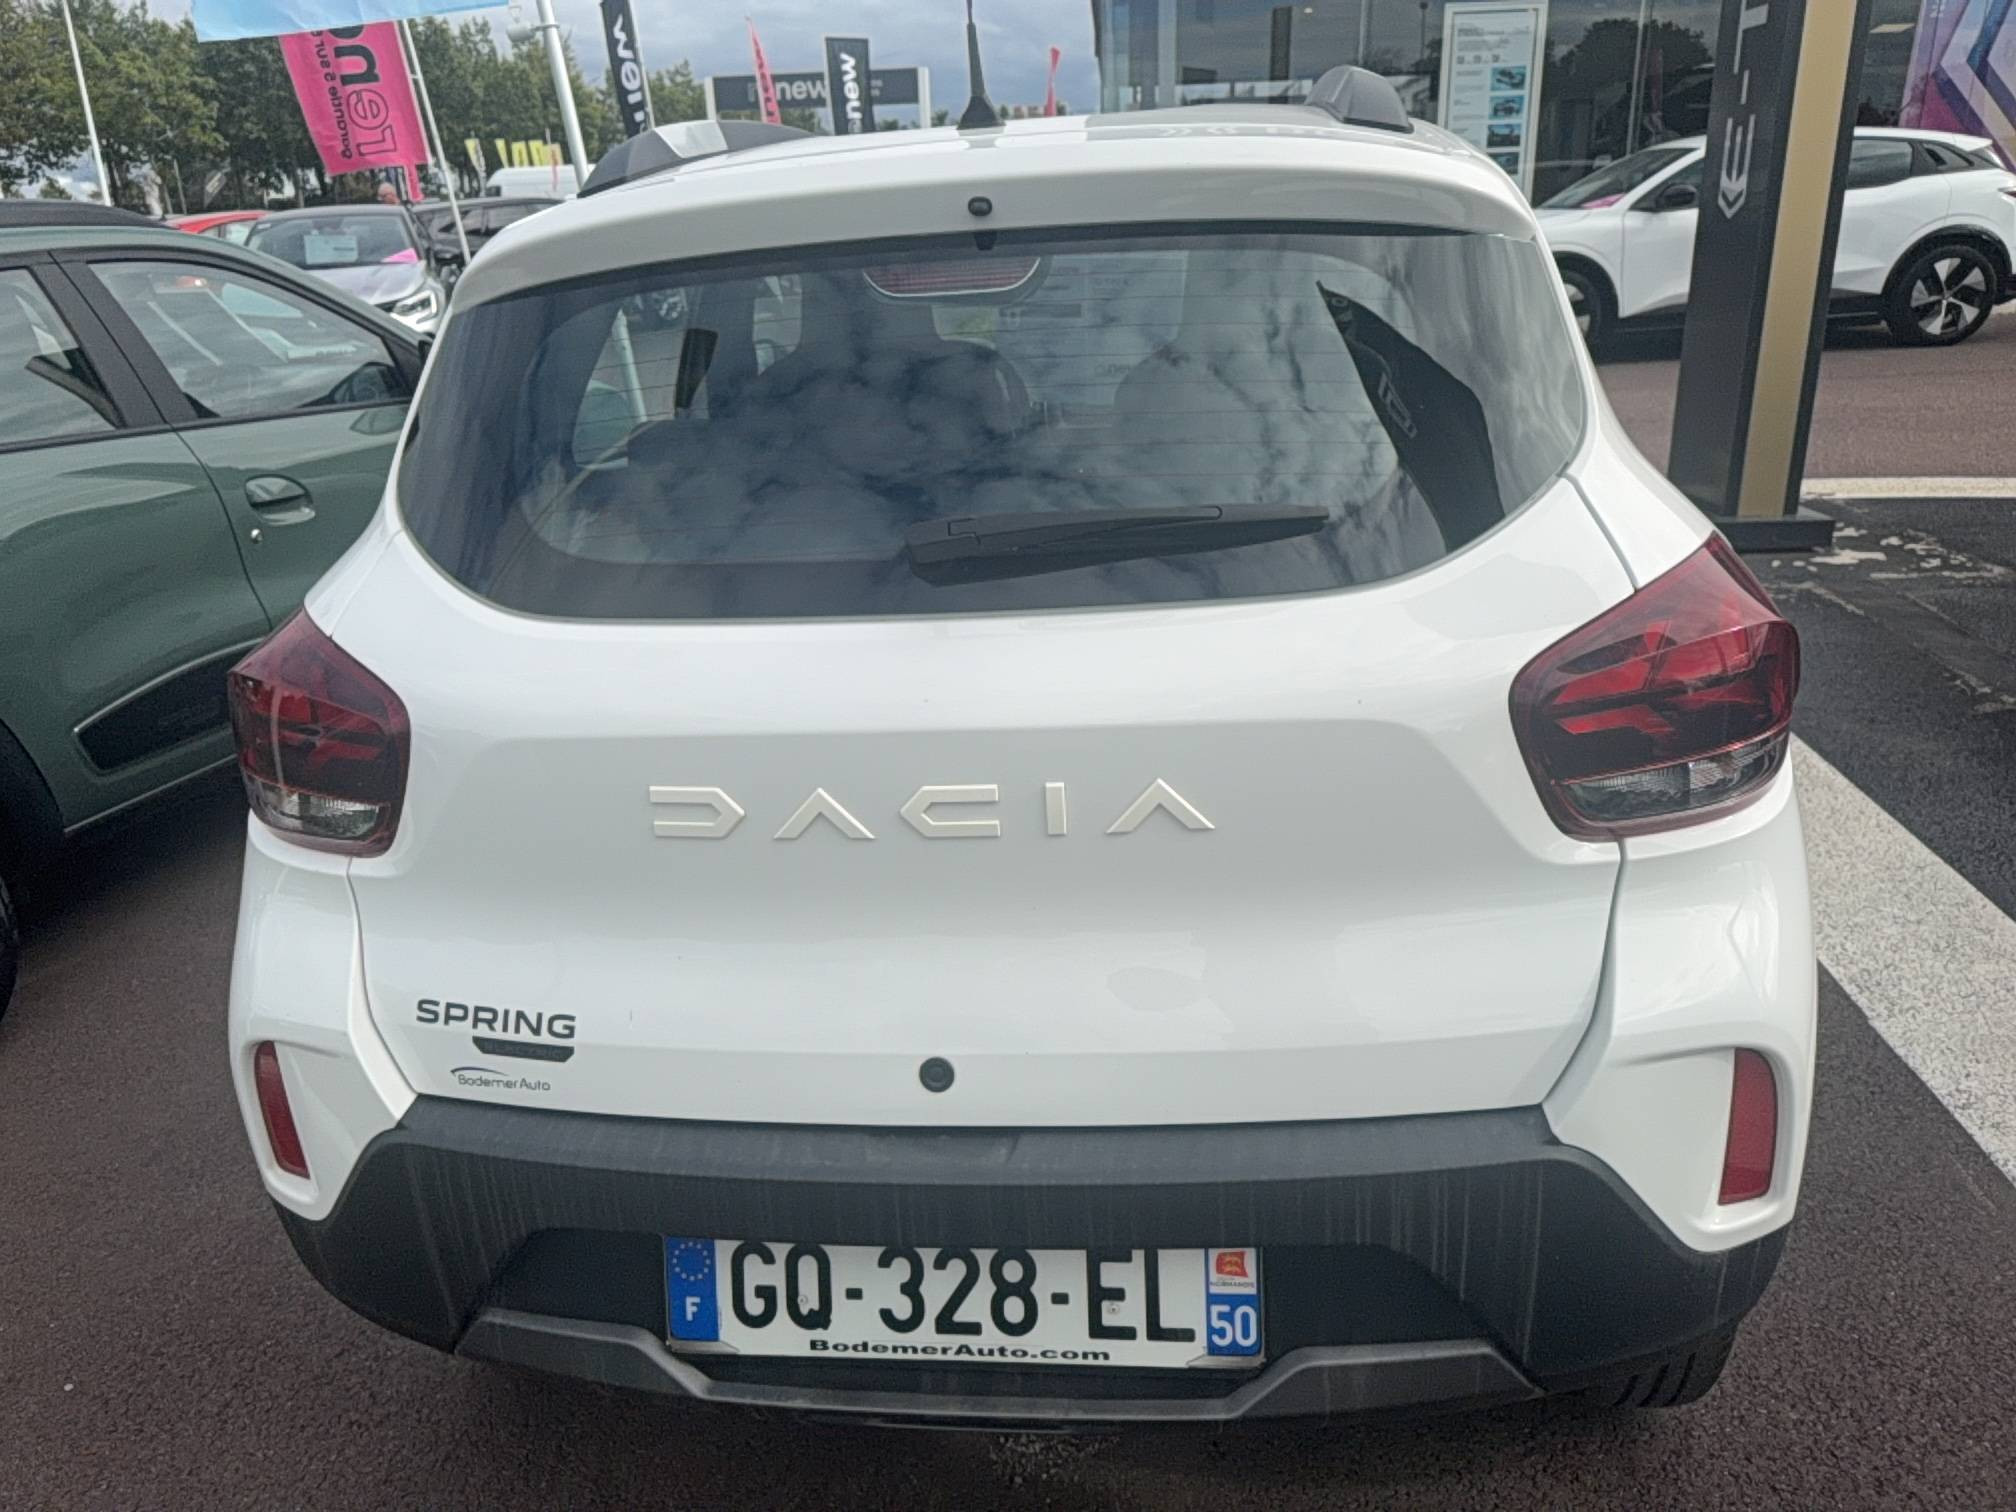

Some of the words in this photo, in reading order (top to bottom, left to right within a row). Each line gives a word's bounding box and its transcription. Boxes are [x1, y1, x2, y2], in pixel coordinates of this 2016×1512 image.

[649, 777, 1216, 839] DACIA
[416, 999, 577, 1039] SPRING
[685, 1296, 701, 1321] F
[731, 1240, 1197, 1343] GQ-328-EL
[1210, 1304, 1257, 1347] 50
[809, 1337, 1111, 1361] BodemerAuto.com
